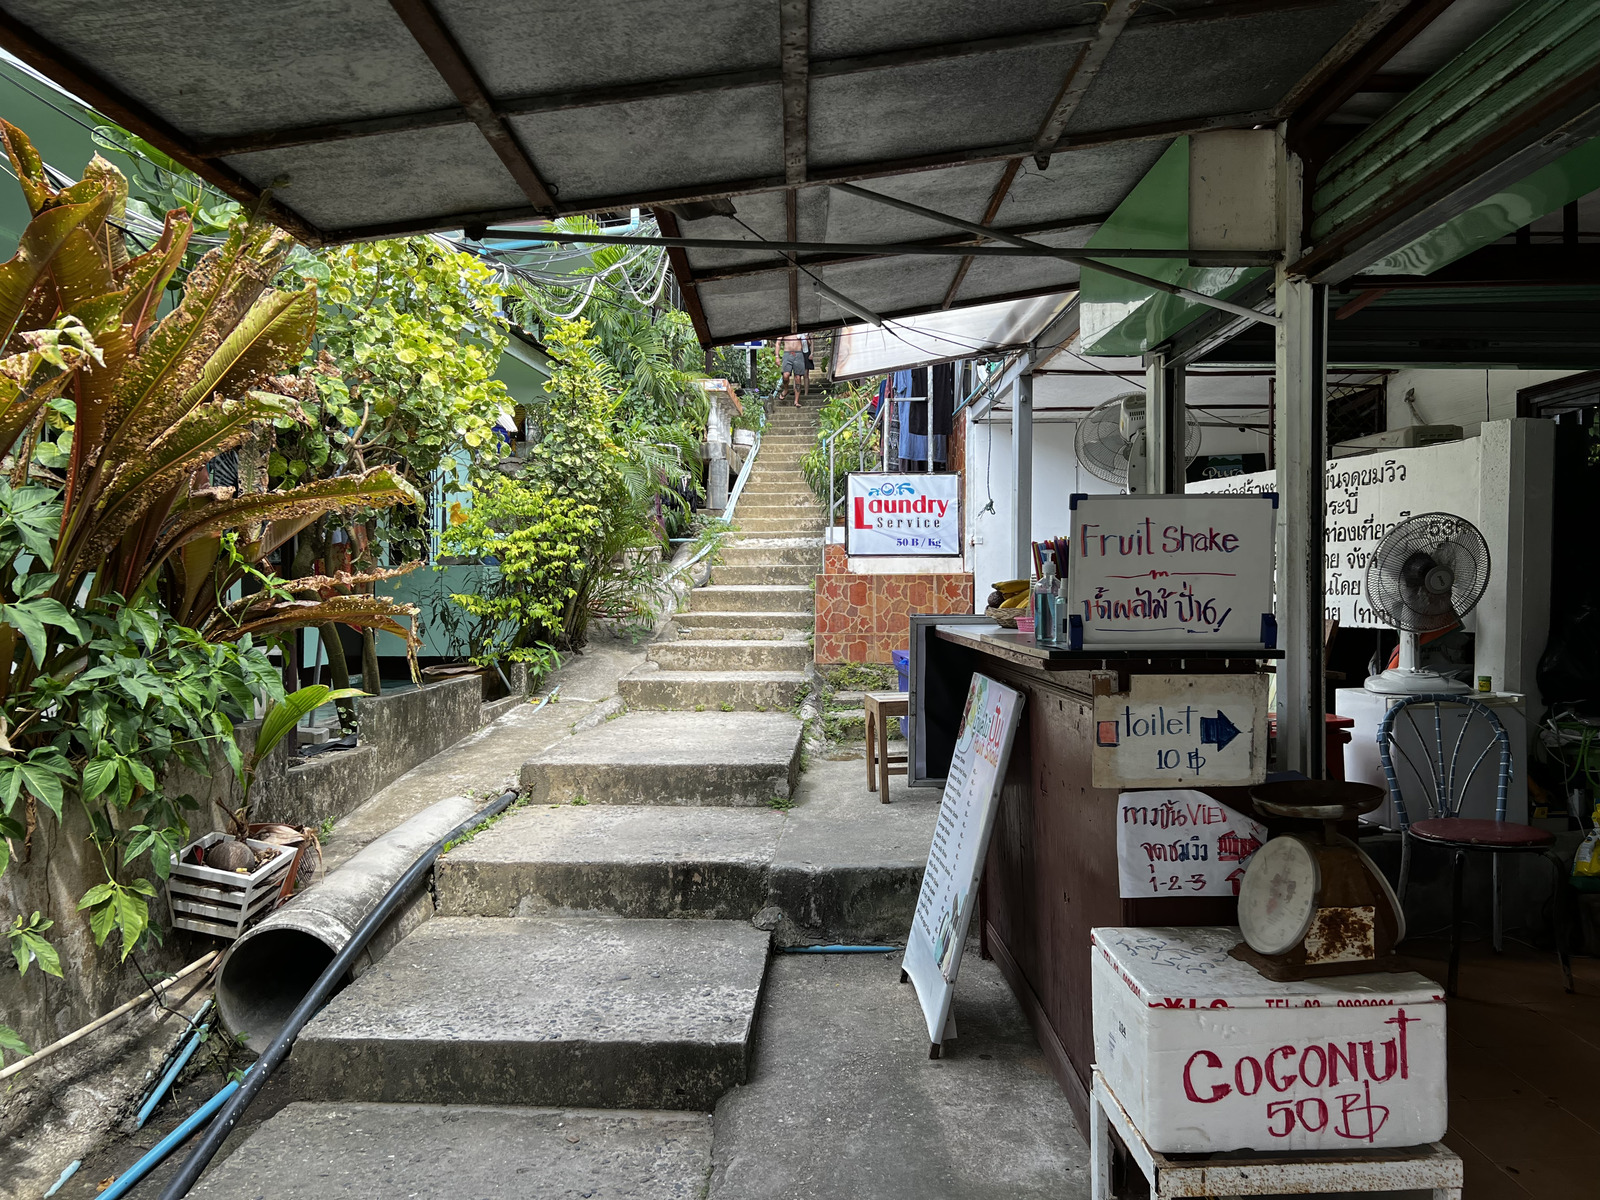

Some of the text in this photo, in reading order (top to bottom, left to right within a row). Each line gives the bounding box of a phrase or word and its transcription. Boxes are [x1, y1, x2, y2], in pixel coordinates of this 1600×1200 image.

[854, 495, 949, 529] Laundry
[877, 517, 940, 528] Service
[896, 538, 909, 547] 50
[928, 538, 942, 548] Kg
[1081, 517, 1240, 558] Fruit Shake
[1121, 705, 1199, 737] toilet
[1155, 749, 1181, 770] 10
